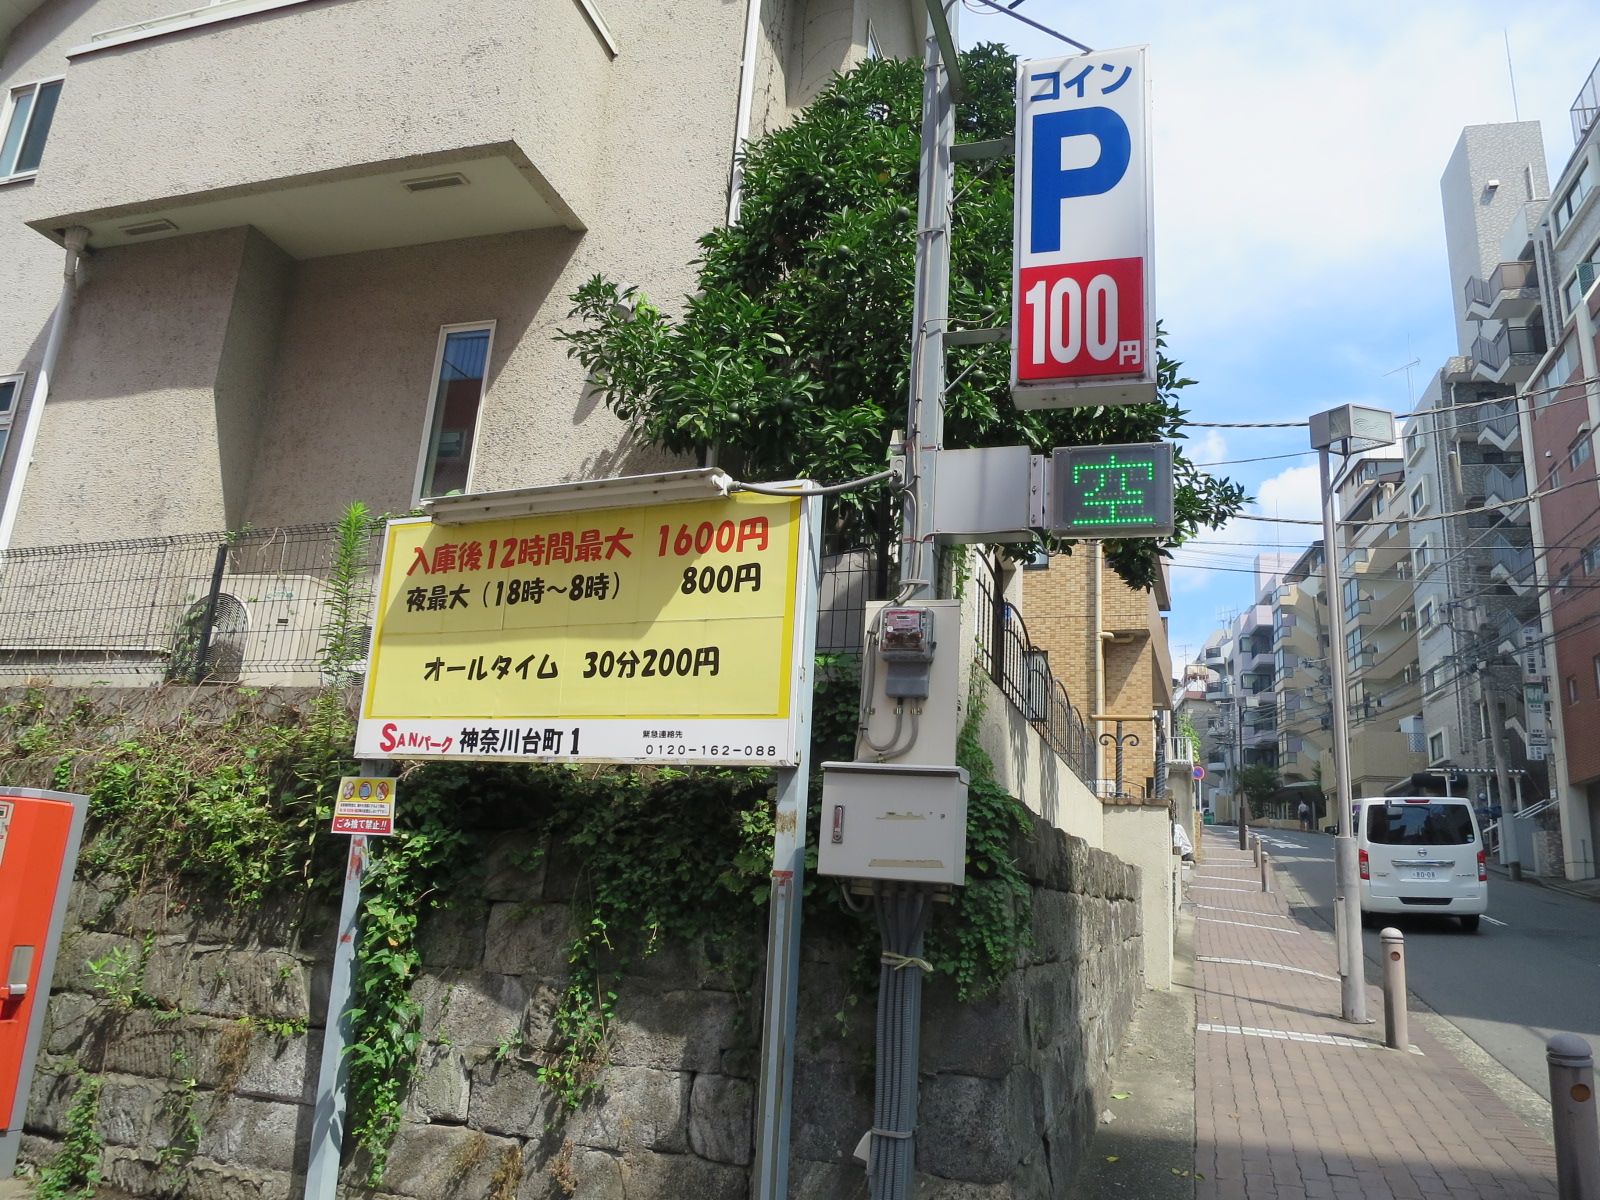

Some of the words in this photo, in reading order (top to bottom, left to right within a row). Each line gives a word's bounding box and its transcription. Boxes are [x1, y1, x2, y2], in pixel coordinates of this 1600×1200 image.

[1030, 62, 1133, 101] コイン
[1030, 106, 1132, 254] P
[1025, 273, 1141, 367] 100円
[1073, 455, 1154, 526] 空
[406, 527, 634, 577] 入庫後12時間最大
[658, 516, 769, 557] 1600円
[681, 562, 762, 595] 800円
[424, 654, 559, 682] オールタイム
[583, 646, 720, 679] 30分200円
[642, 730, 683, 739] 緊急連絡先
[645, 744, 776, 756] 0120-162-088
